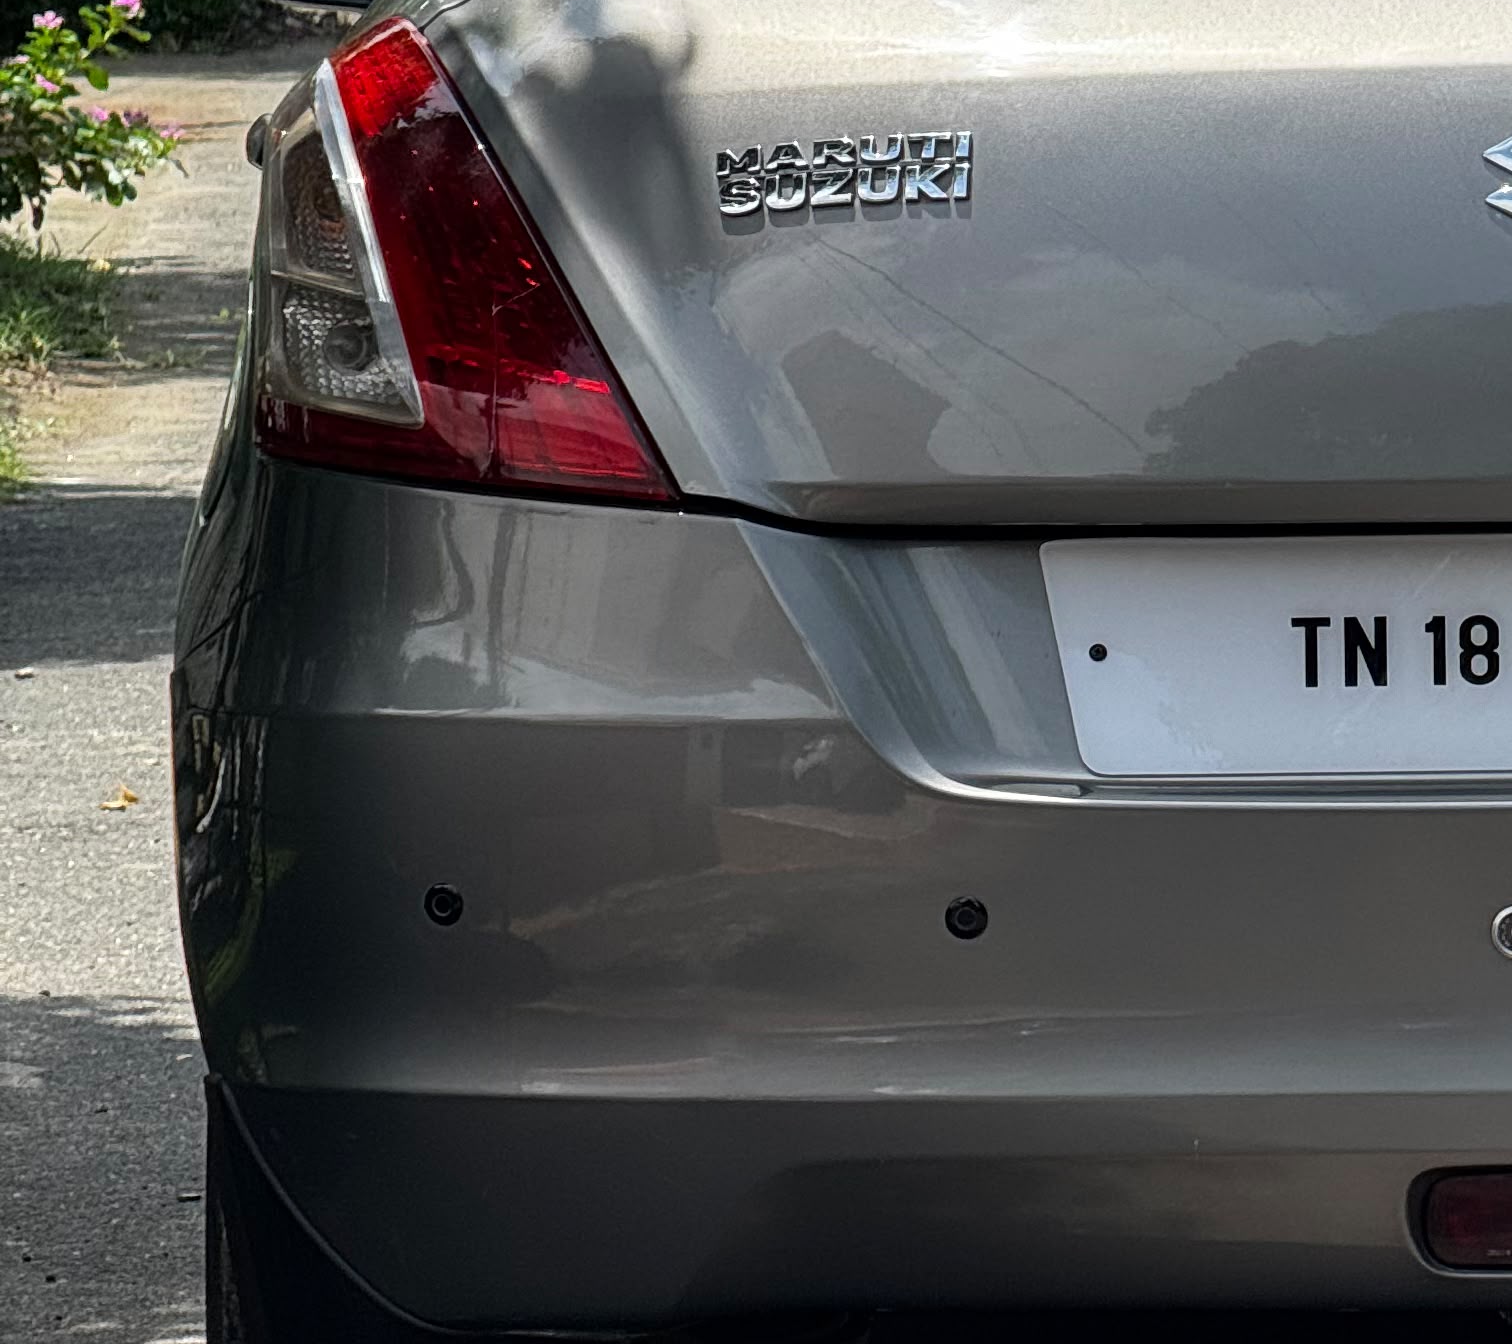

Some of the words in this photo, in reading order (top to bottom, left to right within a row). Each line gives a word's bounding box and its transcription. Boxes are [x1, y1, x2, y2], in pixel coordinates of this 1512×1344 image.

[715, 130, 974, 177] MARUTI
[718, 161, 973, 217] SUZUKI
[1290, 615, 1389, 688] TN
[1423, 613, 1501, 686] 18
